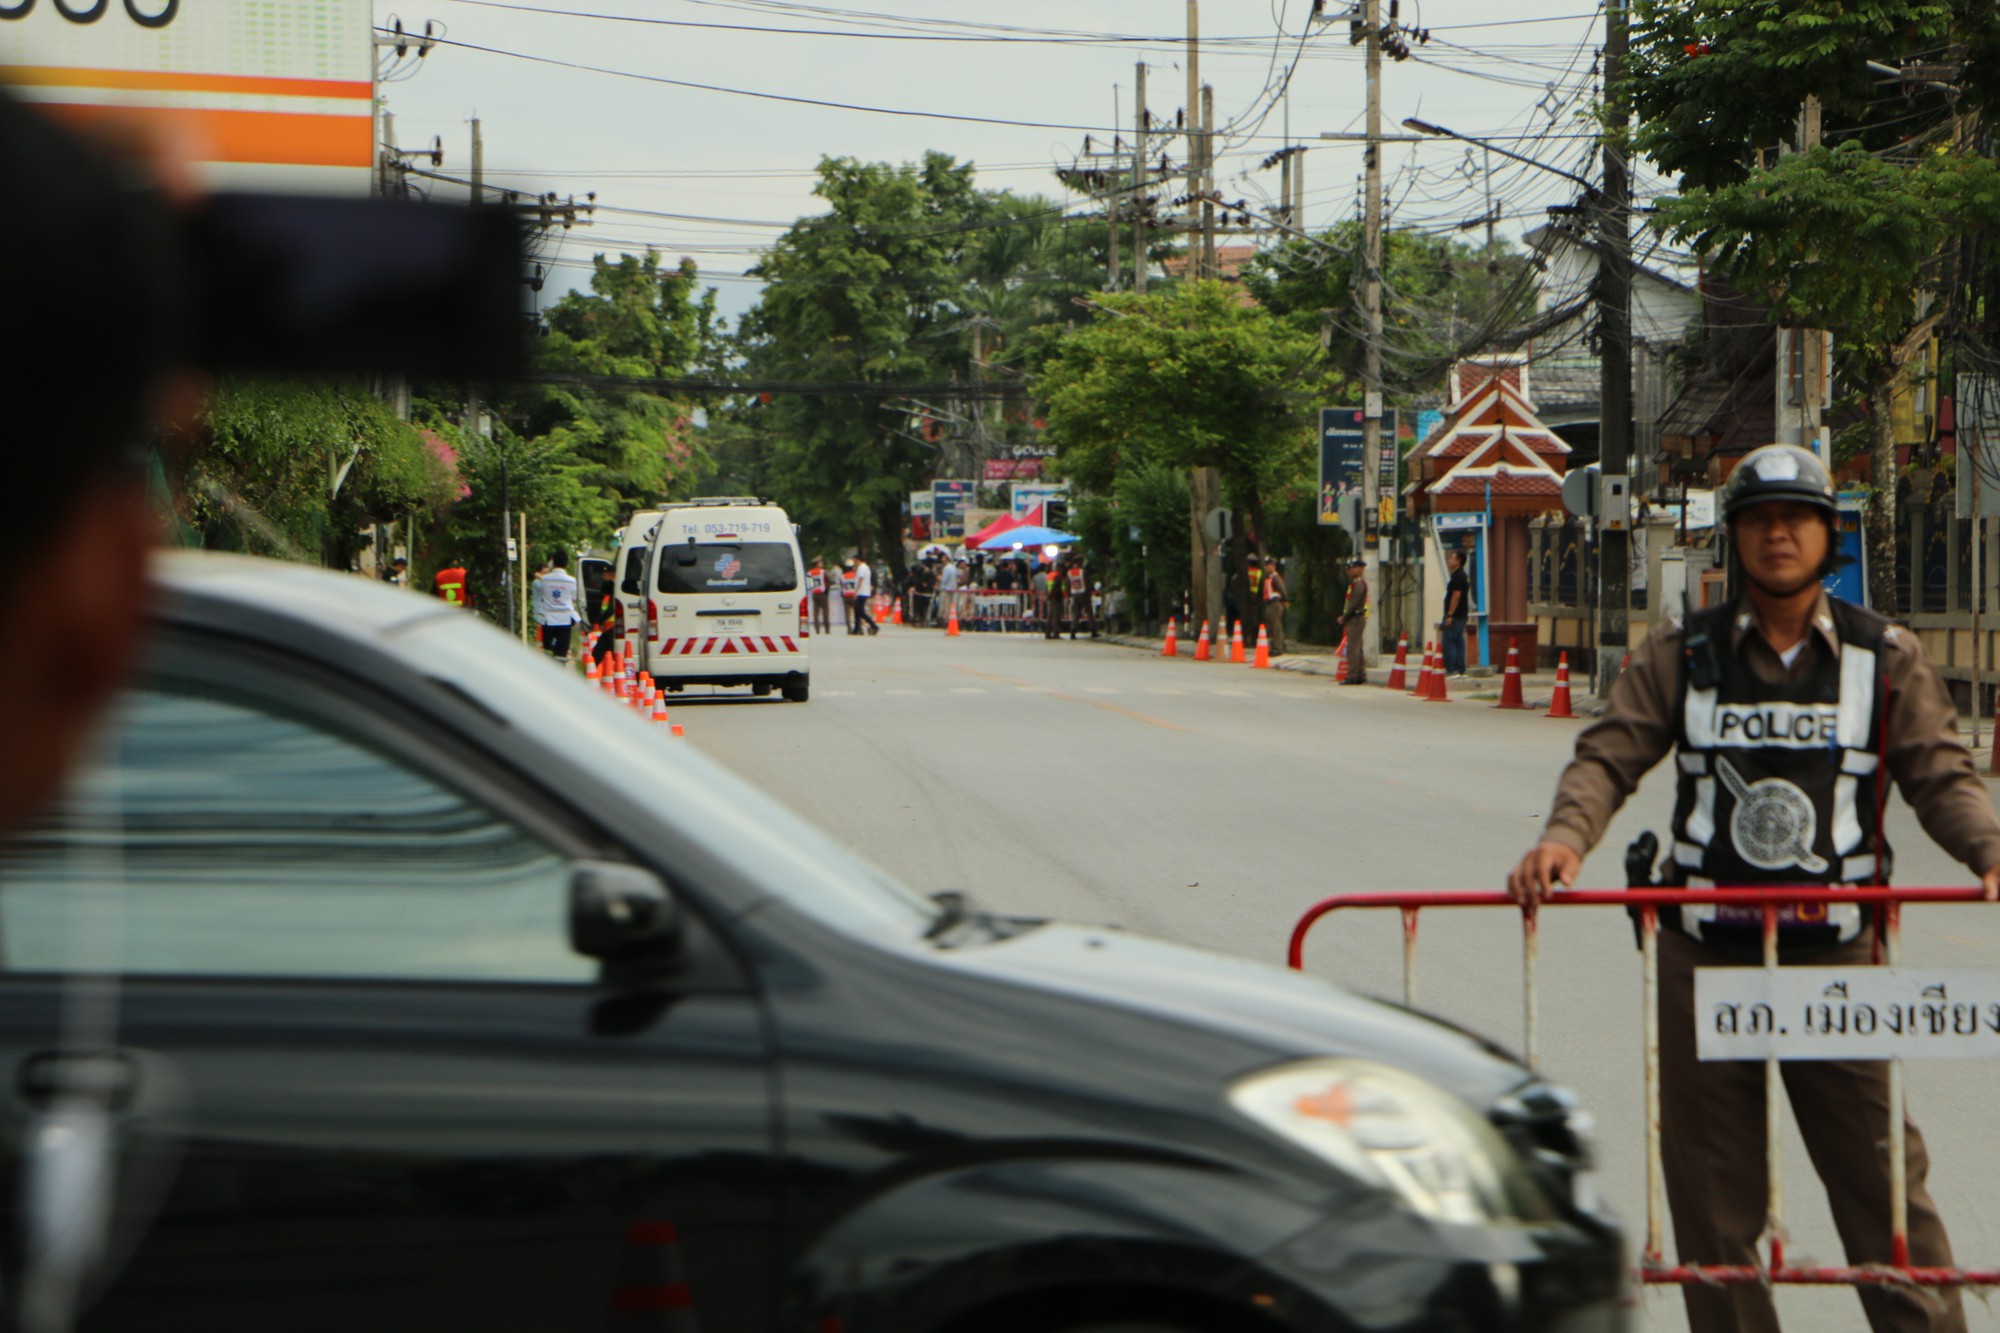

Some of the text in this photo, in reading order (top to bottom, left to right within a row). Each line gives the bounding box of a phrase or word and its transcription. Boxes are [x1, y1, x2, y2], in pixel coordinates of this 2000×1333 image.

[682, 523, 770, 534] Tel. 053-719-719
[1719, 710, 1838, 740] POLICE
[1714, 1001, 1788, 1036] สภ.
